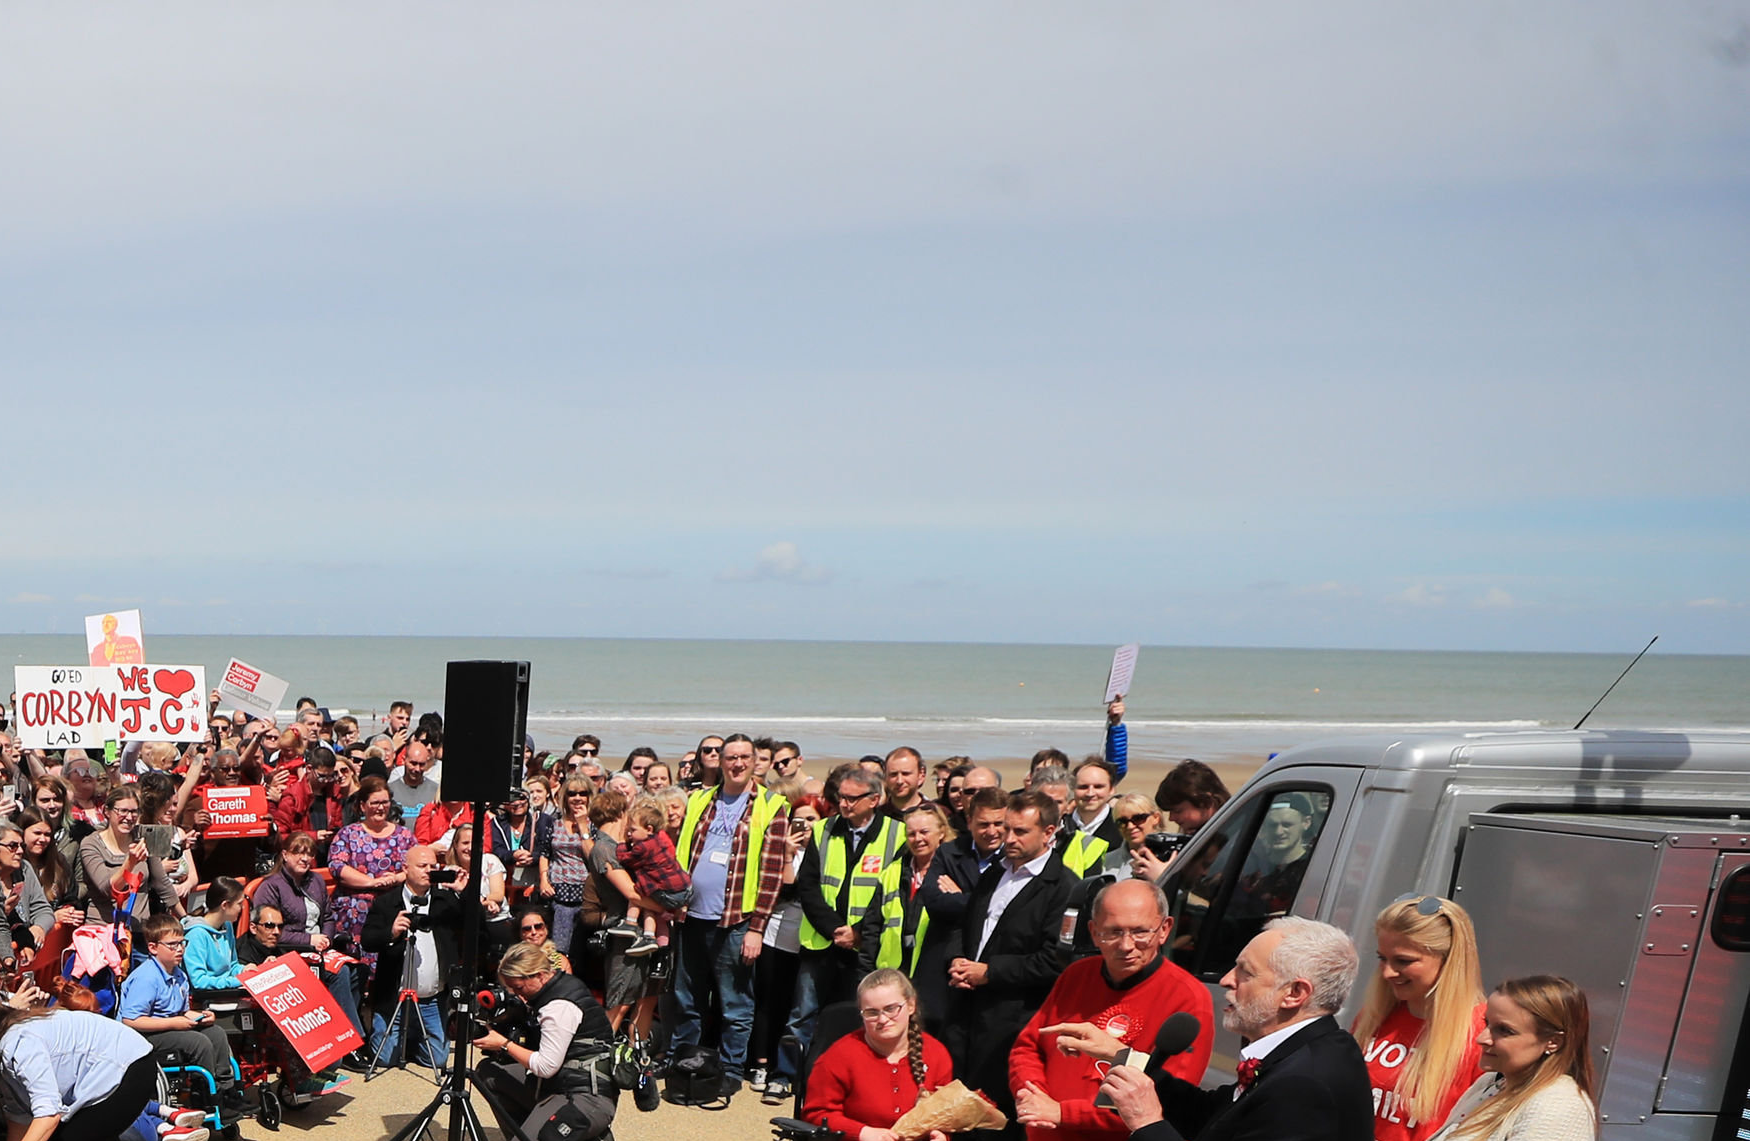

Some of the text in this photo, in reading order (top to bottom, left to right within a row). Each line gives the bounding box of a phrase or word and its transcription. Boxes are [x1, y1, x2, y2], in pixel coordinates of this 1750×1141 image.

[117, 666, 151, 694] WE
[227, 673, 253, 690] Corbyn
[231, 664, 258, 681] Jeremy
[22, 688, 116, 727] CORBYN
[46, 730, 81, 745] LAD
[208, 798, 246, 811] Gareth
[210, 812, 257, 824] Thomas
[263, 983, 307, 1015] Gareth
[280, 1005, 331, 1039] Thomas
[1364, 1038, 1416, 1068] VO
